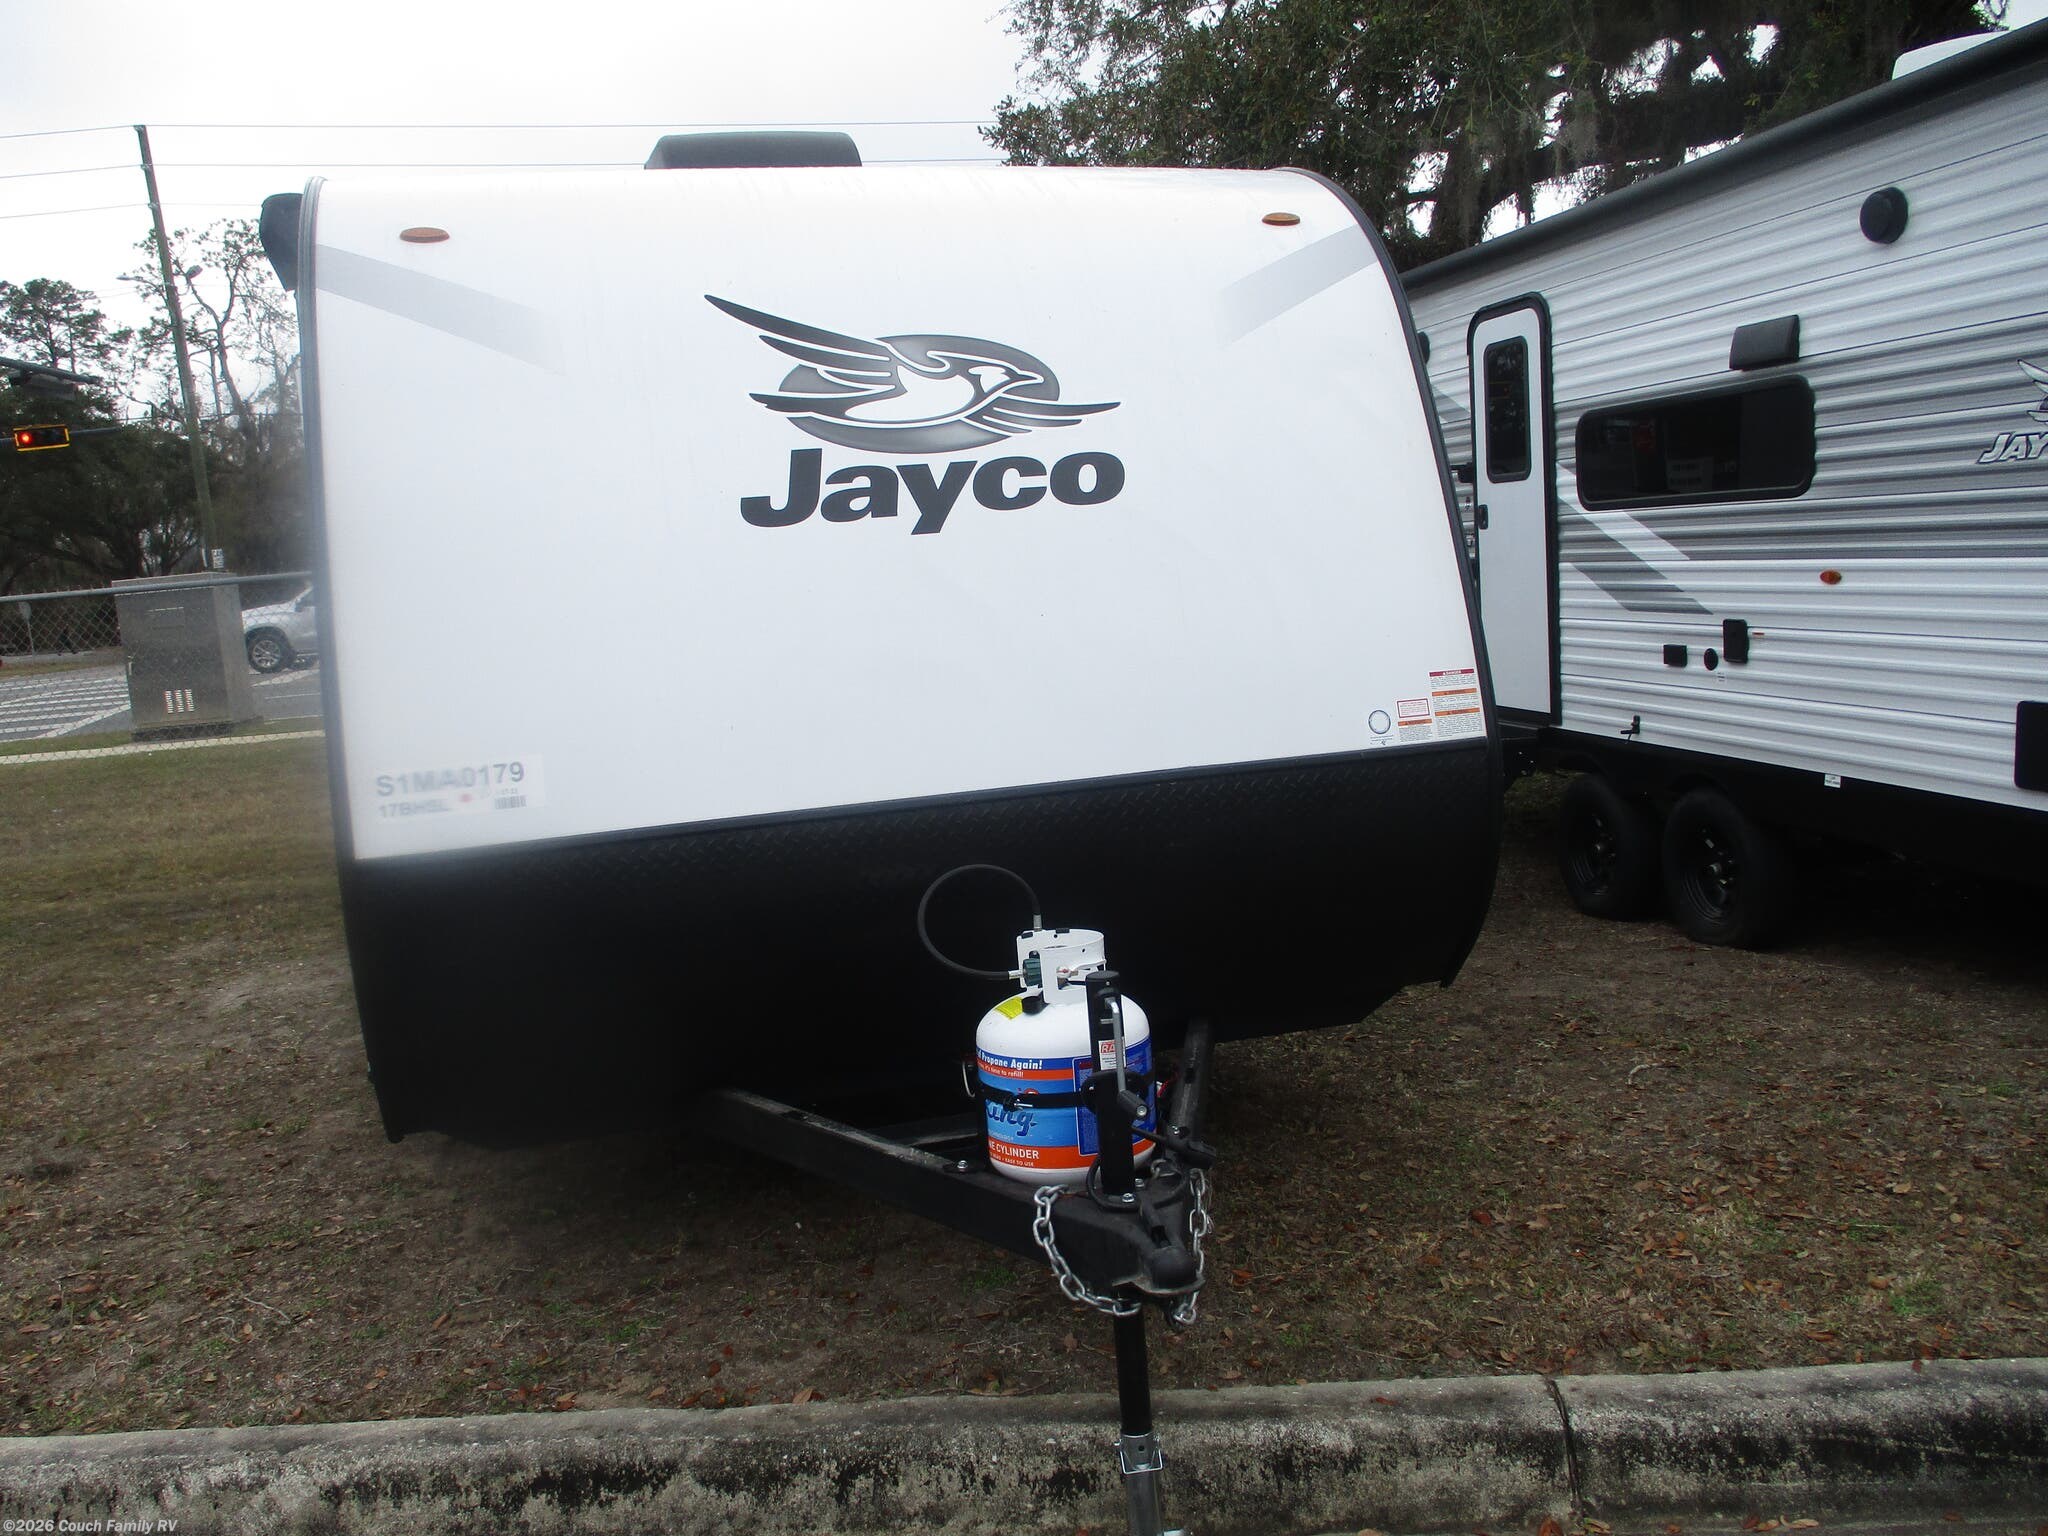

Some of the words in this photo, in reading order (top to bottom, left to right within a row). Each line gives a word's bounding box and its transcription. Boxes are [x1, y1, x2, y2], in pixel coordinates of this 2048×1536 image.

[740, 447, 1126, 536] Jayco
[1101, 1041, 1115, 1053] RA
[981, 1051, 1008, 1067] Propane
[1010, 1058, 1043, 1070] Again!
[1007, 1070, 1024, 1078] refill!
[996, 1143, 1040, 1160] CYLINDER
